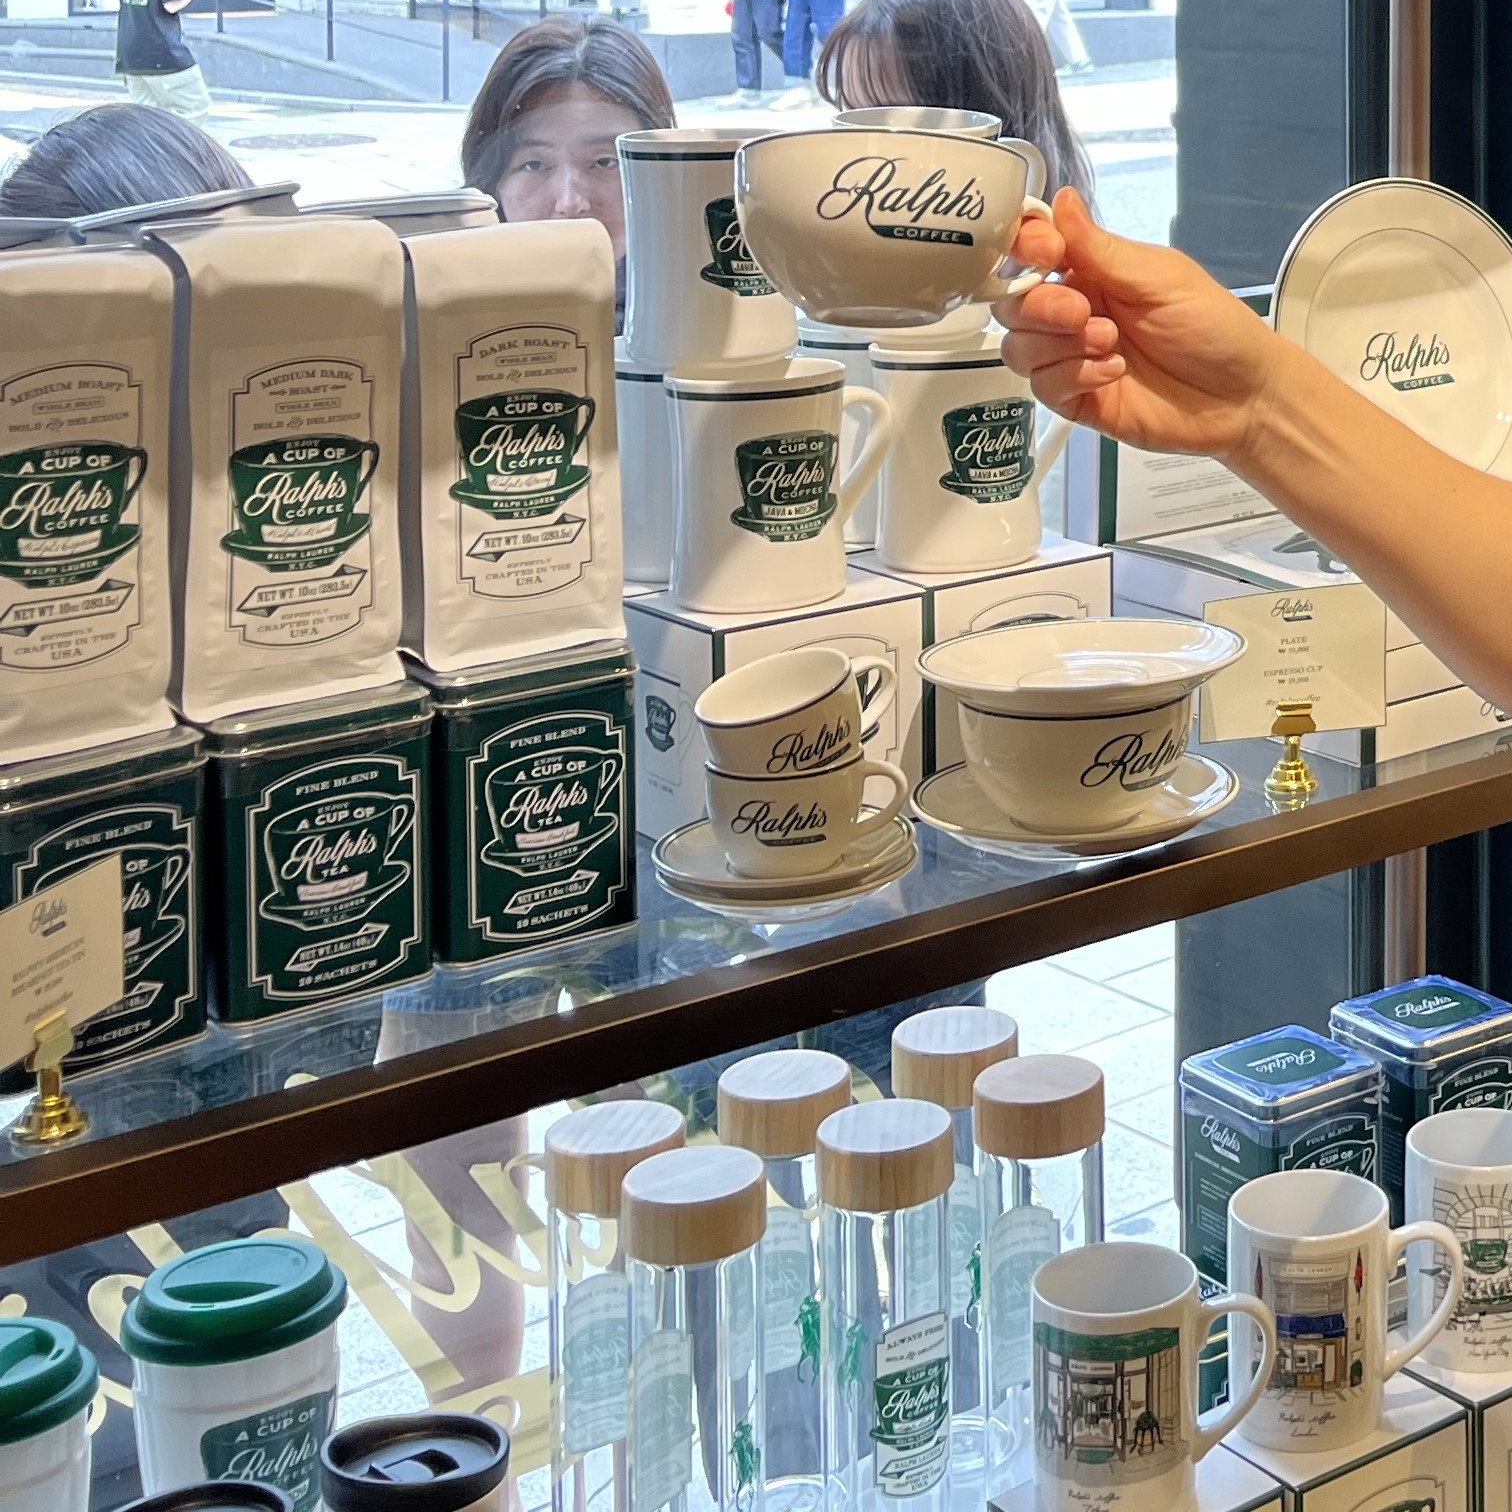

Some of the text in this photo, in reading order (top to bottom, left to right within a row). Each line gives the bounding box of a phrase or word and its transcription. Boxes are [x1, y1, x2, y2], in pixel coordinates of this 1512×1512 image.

[817, 156, 985, 224] Ralph's
[893, 227, 961, 243] COFFEE
[1360, 331, 1451, 381] Ralph's
[1403, 375, 1443, 389] COFFEE
[486, 402, 564, 418] A CUP OF
[982, 410, 1008, 421] CUP
[469, 424, 565, 475] Ralph's
[778, 443, 807, 454] CUP
[19, 454, 112, 475] A CUP OF
[262, 448, 346, 466] A CUP OF
[508, 455, 563, 469] COFFEE
[747, 460, 825, 504] Ralph's
[243, 470, 348, 525] Ralph's
[493, 500, 521, 508] RALPH
[0, 479, 114, 538] Ralph's
[285, 504, 345, 519] COFFEE
[44, 514, 109, 531] COFFEE
[484, 537, 502, 548] NET
[267, 552, 297, 561] RALPH
[24, 566, 57, 575] RALPH
[516, 576, 543, 586] USA
[256, 590, 277, 604] NET
[14, 607, 36, 622] NET
[1271, 597, 1314, 618] Ralph's
[1280, 636, 1307, 645] PLATE
[52, 648, 82, 660] USA
[1264, 665, 1323, 677] ESPRESSO CUP
[510, 726, 587, 749] FINE BLEND
[514, 760, 587, 782] A CUP OF
[295, 770, 379, 796] FINE BLEND
[501, 781, 588, 832] Ralph's
[297, 807, 376, 831] A CUP OF
[537, 815, 563, 827] TEA
[731, 800, 827, 838] Ralph's
[280, 828, 377, 884] Ralph's
[125, 859, 148, 872] OF
[321, 865, 349, 878] TEA
[1465, 1095, 1483, 1107] CUP
[1201, 1115, 1240, 1152] Ralph's
[1319, 1150, 1354, 1166] CUP OF
[887, 1333, 923, 1350] ALWAYS
[905, 1372, 925, 1384] CUP
[235, 1407, 317, 1443] A CUP OF
